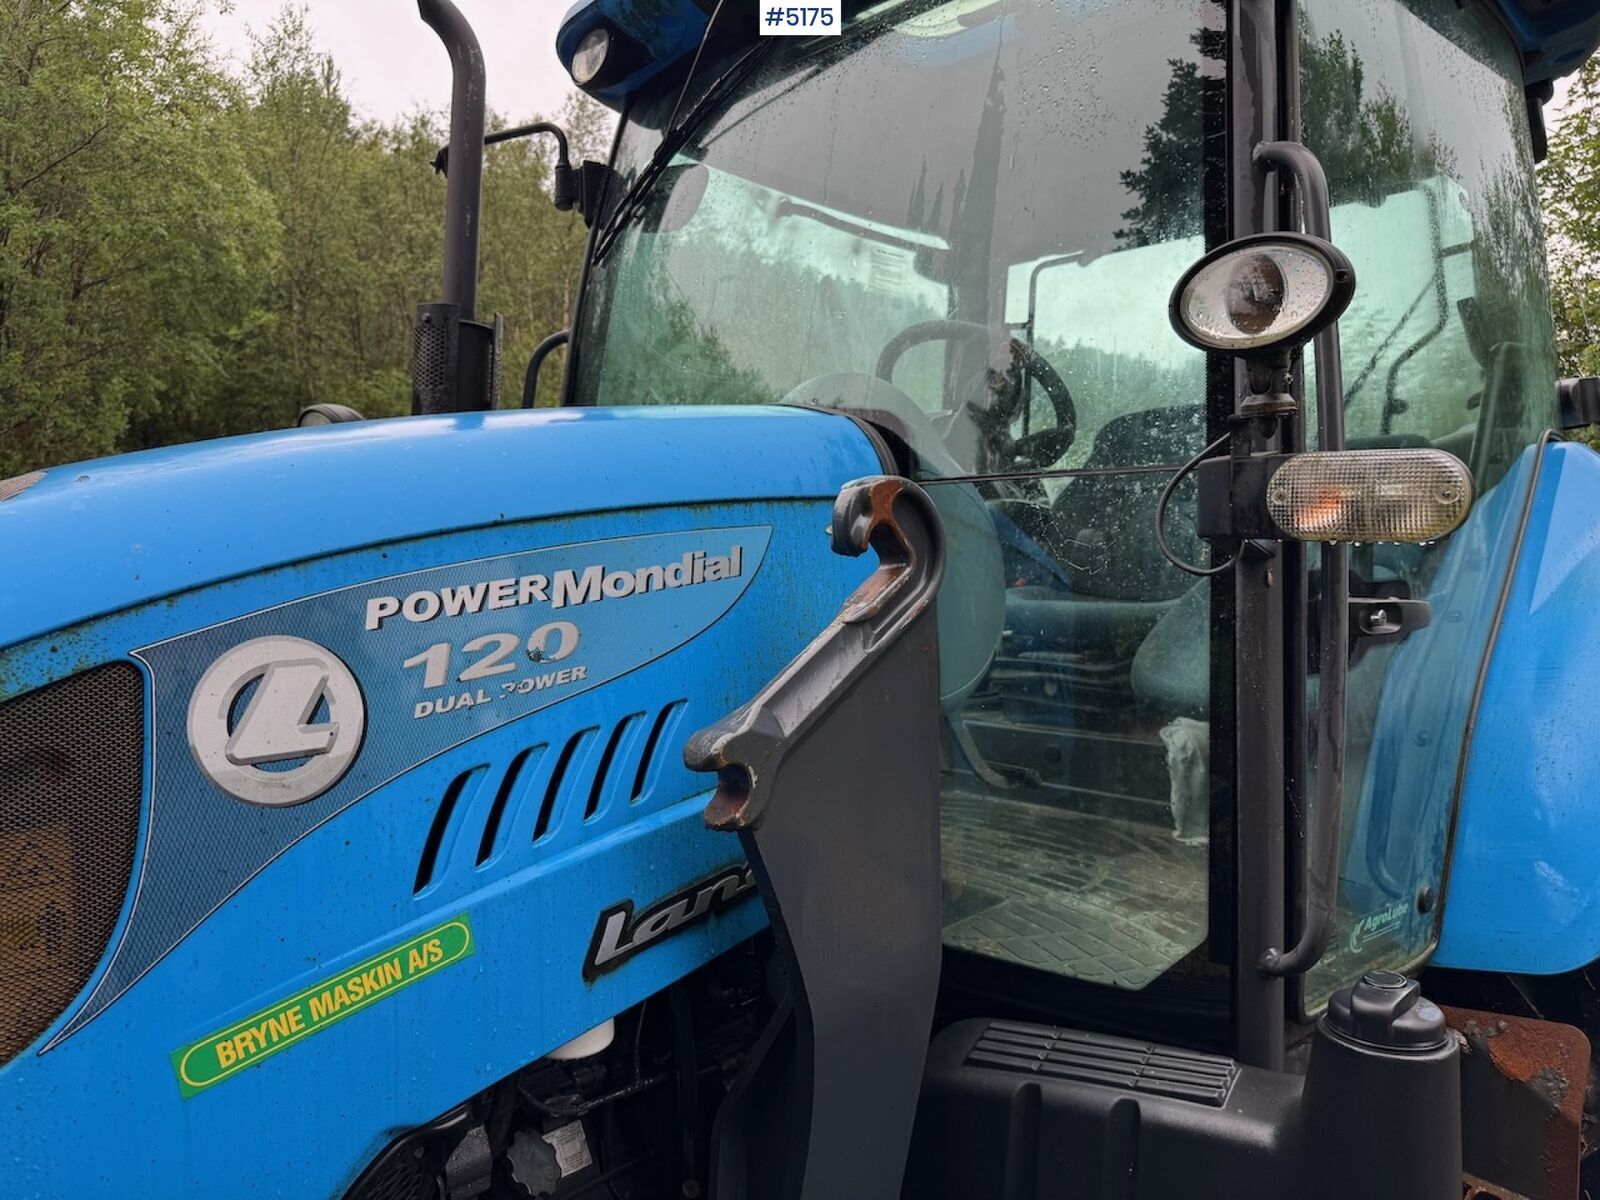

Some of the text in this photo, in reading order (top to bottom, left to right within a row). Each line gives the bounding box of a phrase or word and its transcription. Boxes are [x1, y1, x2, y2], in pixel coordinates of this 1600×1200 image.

[365, 545, 742, 631] POWERMondial
[403, 621, 579, 689] 120
[414, 689, 492, 720] DUAL
[595, 869, 757, 966] Lan
[1364, 903, 1409, 932] AgroLube
[215, 938, 444, 1069] BRYNE MASKIN A/S
